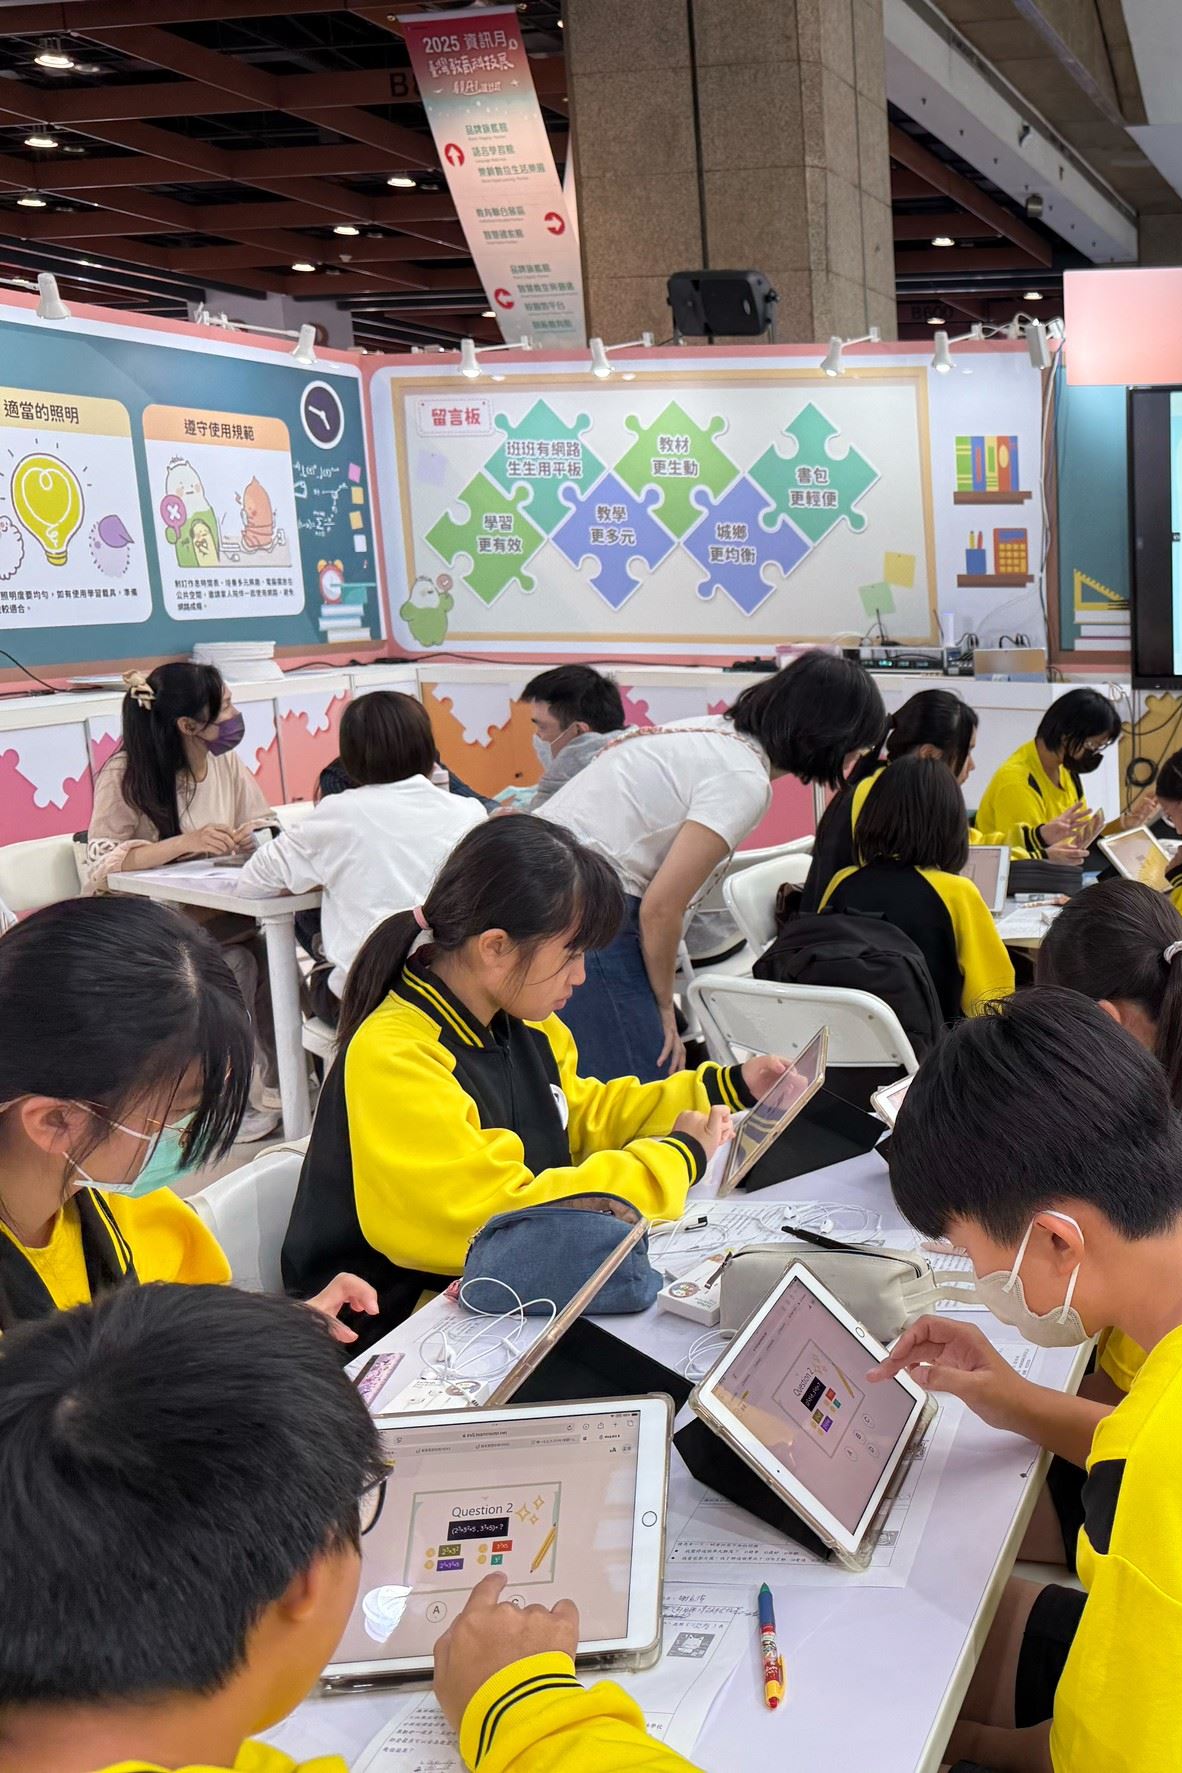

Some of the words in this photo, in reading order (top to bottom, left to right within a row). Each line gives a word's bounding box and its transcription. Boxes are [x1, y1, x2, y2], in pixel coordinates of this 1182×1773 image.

[423, 35, 461, 53] 2025
[463, 30, 508, 50] 資訊月
[4, 400, 80, 425] 適當的照明
[431, 407, 481, 427] 留言板
[184, 418, 255, 442] 遵守使用規範
[506, 440, 582, 459] 班班有網路
[659, 435, 690, 454] 教材
[507, 460, 583, 479] 生生用平板
[651, 457, 699, 478] 更生動
[797, 466, 829, 485] 書包
[790, 489, 838, 509] 更輕便
[484, 514, 513, 532] 學習
[597, 505, 628, 522] 教學
[591, 527, 636, 546] 更多元
[716, 522, 748, 541] 城鄉
[477, 535, 523, 554] 更有效
[708, 545, 757, 565] 更均衡
[0, 604, 31, 615] 較適合。
[793, 1373, 811, 1396] Question
[452, 1505, 503, 1518] Question
[506, 1503, 513, 1513] 2
[433, 1605, 440, 1614] A
